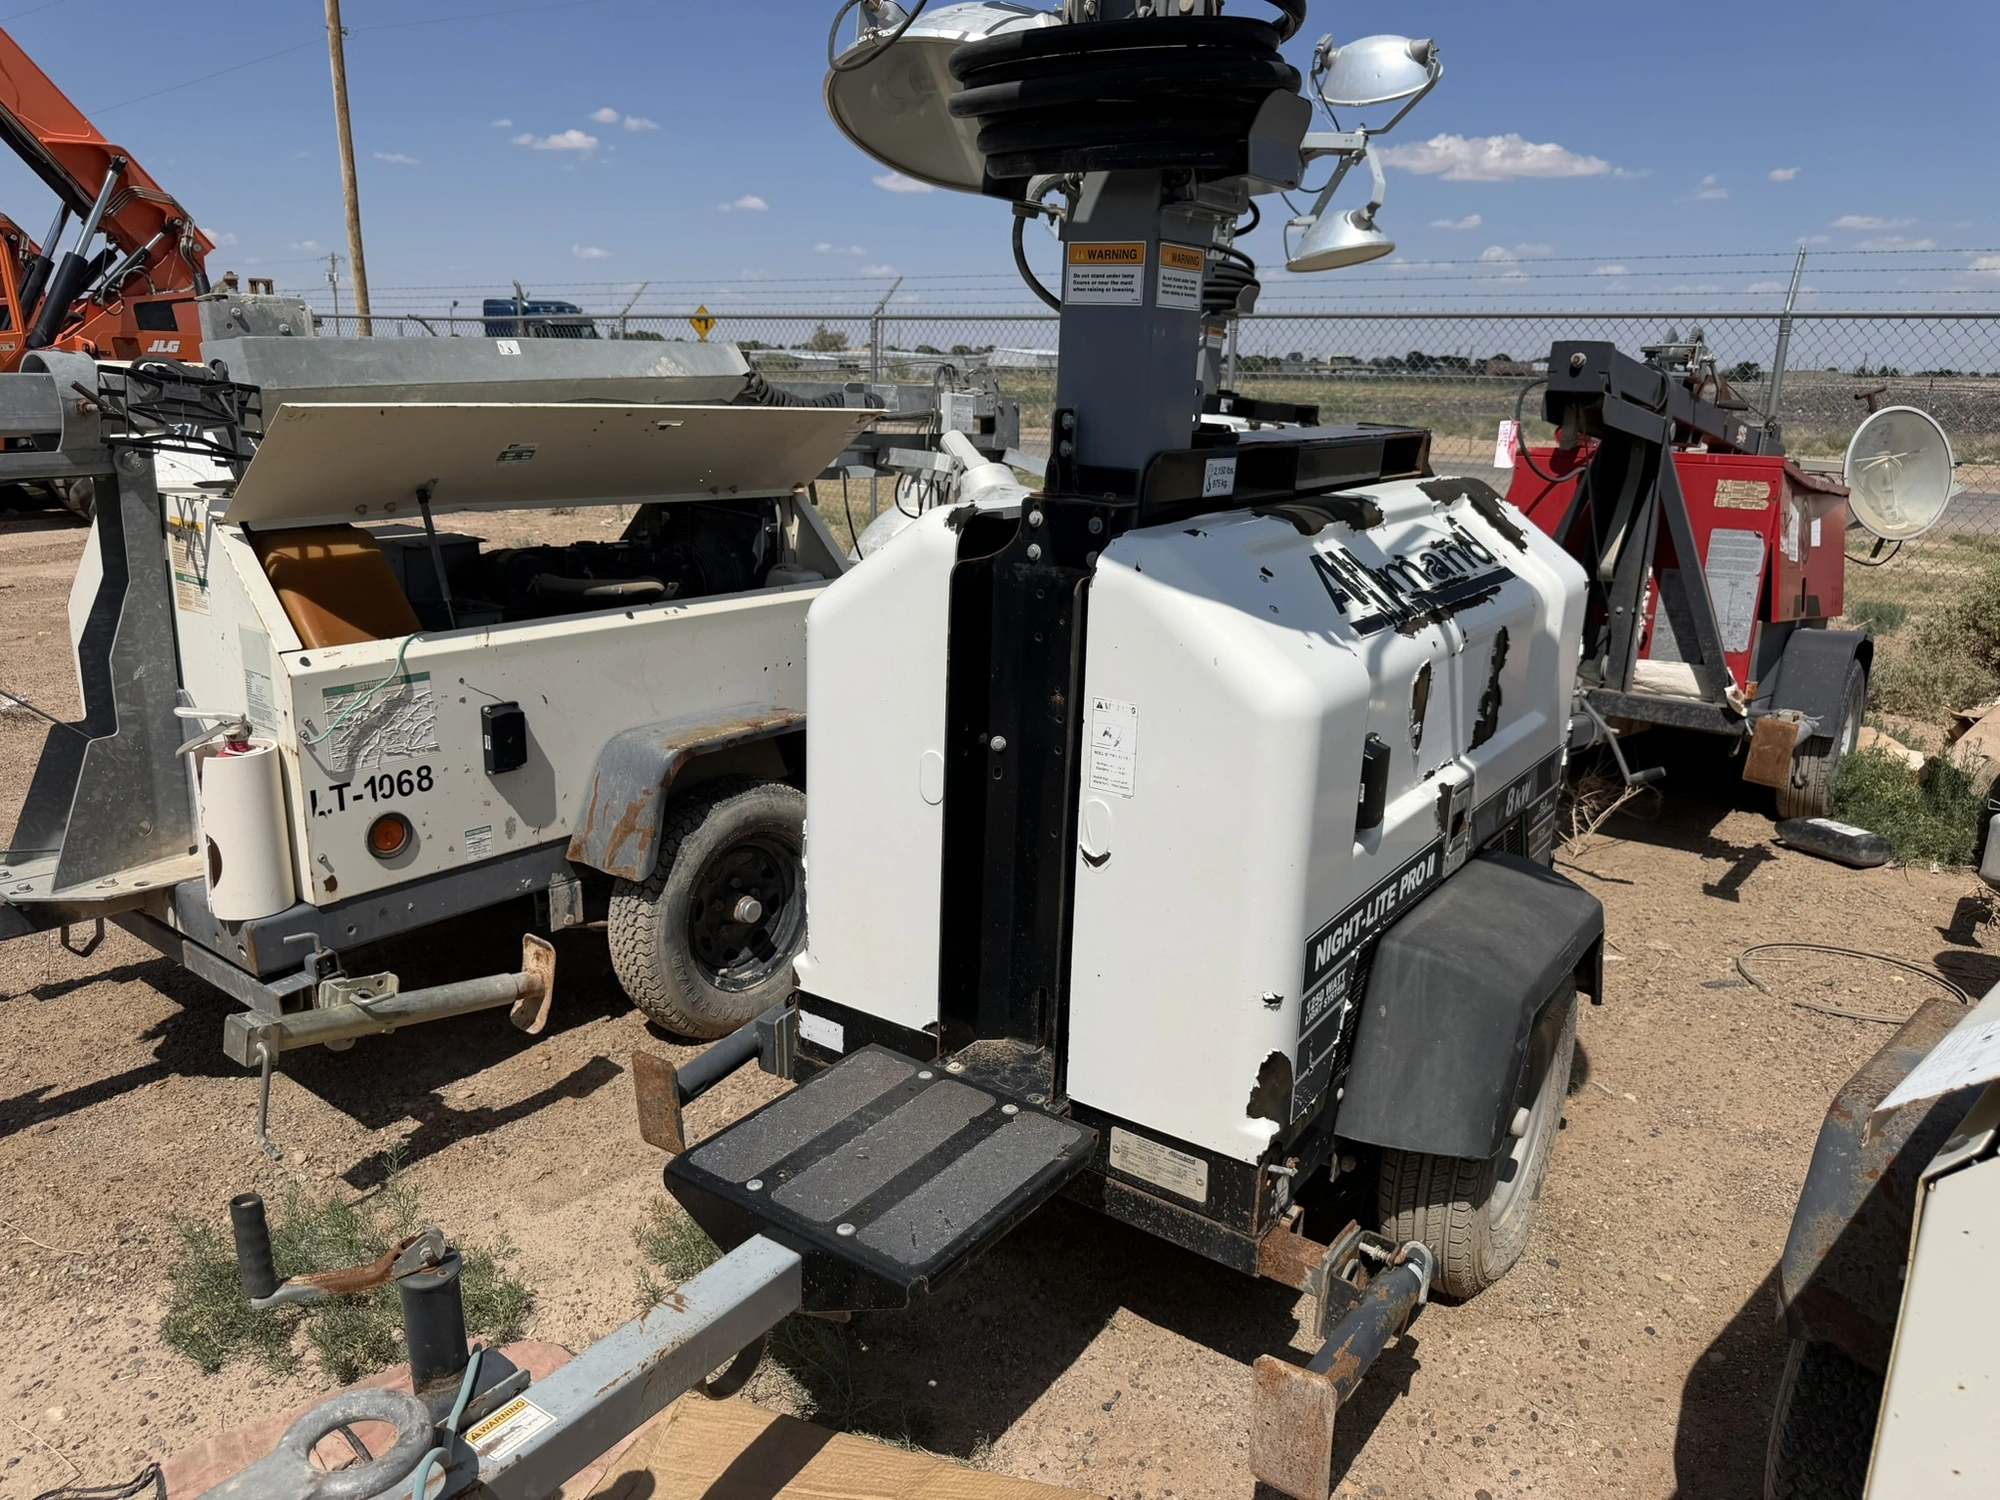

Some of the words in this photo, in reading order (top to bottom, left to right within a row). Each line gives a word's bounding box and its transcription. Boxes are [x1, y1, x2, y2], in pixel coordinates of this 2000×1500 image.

[1087, 249, 1138, 260] WARNING
[1171, 252, 1200, 266] WARNING
[147, 339, 181, 353] JLG
[168, 422, 199, 438] 371
[309, 764, 434, 819] LT-1068
[1314, 881, 1398, 972] NIGHT-LITE
[1398, 860, 1426, 901] PRO
[1426, 852, 1436, 879] II
[1304, 1001, 1323, 1027] LIGHT
[1323, 980, 1347, 1009] SYSTEM
[1306, 987, 1325, 1014] 1250
[1325, 967, 1348, 994] WATT
[479, 1399, 526, 1433] WARNING
